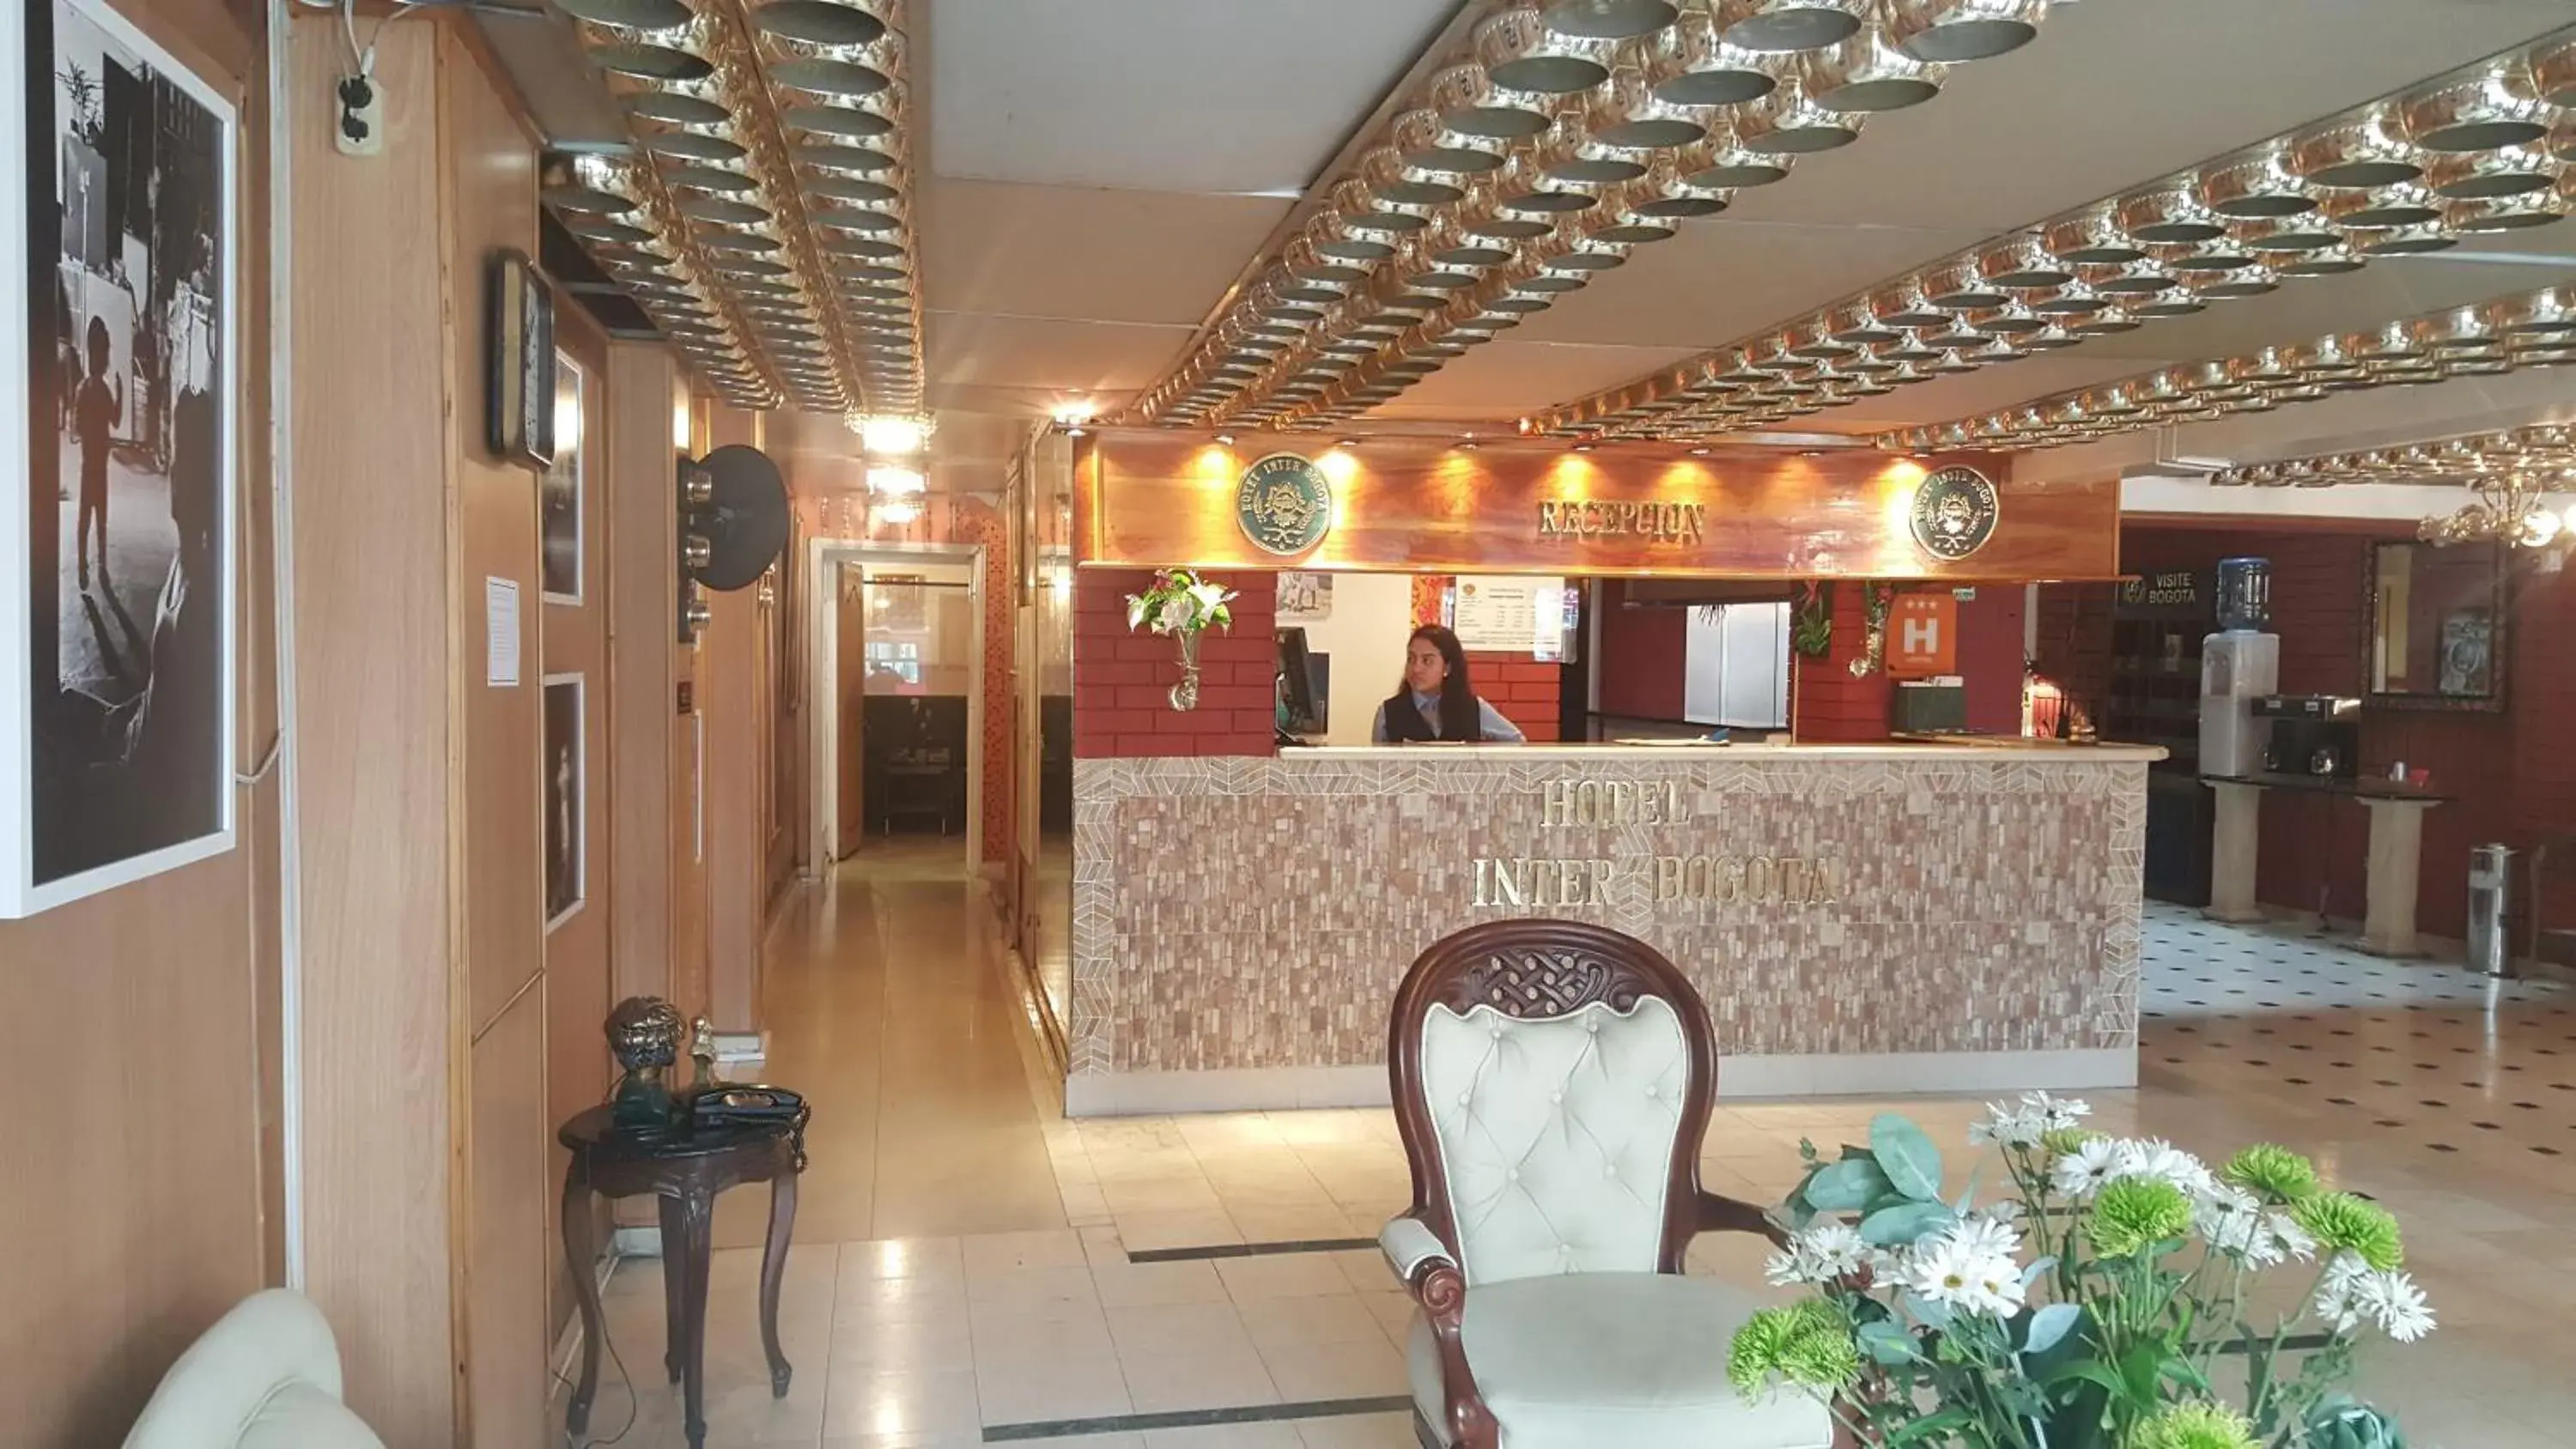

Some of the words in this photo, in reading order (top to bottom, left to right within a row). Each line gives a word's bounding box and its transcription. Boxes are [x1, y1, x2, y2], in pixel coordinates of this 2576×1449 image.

[1264, 460, 1301, 474] INTER
[2157, 573, 2191, 588] VISITE
[2149, 589, 2196, 603] BOGOTA
[1904, 617, 1938, 654] H
[1540, 779, 1692, 828] HOTEL
[1471, 858, 1621, 907] INTER
[1654, 856, 1839, 904] BOGOTA
